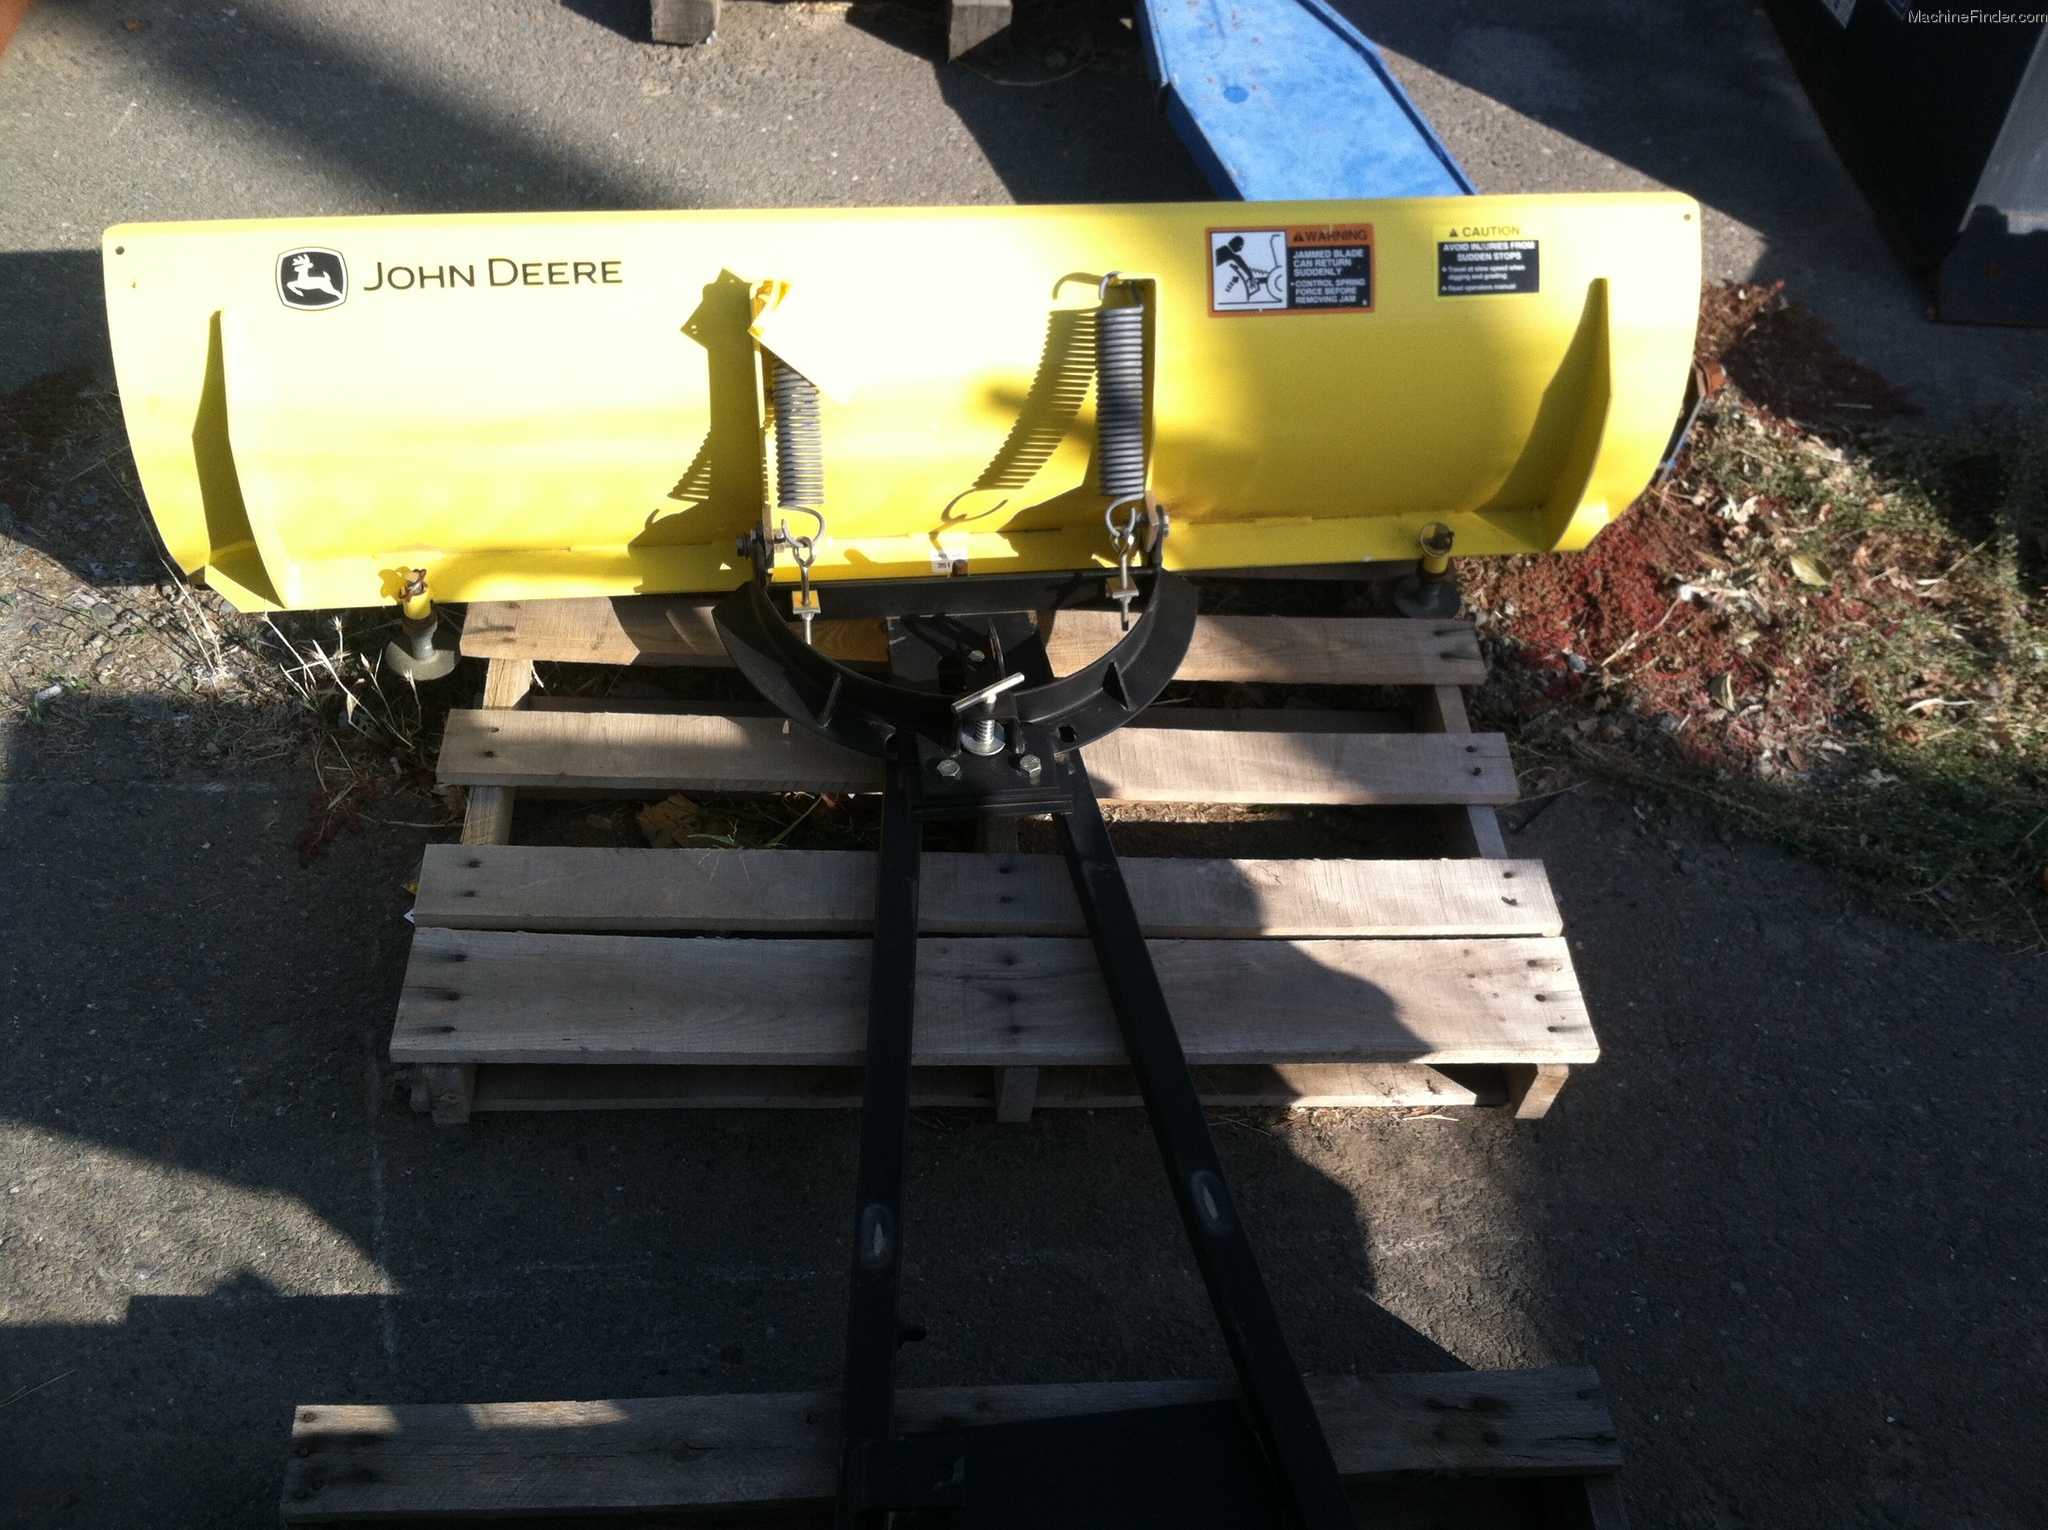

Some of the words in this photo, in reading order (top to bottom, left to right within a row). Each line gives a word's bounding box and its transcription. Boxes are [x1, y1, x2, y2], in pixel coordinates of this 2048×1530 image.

[1305, 230, 1367, 241] WARNING
[1462, 226, 1520, 237] CAUTION
[1443, 243, 1470, 251] AVOID
[1471, 242, 1509, 250] INJURIES
[1510, 241, 1535, 249] FROM
[1293, 250, 1332, 259] JAMMED
[1333, 249, 1364, 258] BLADE
[1457, 253, 1492, 261] SUDDEN
[1493, 251, 1521, 260] STOPS
[1315, 258, 1352, 267] RETURN
[363, 261, 475, 291] JOHN
[488, 258, 623, 287] DEERE
[1293, 268, 1343, 277] SUDDENLY
[1335, 278, 1366, 286] SPRING
[1324, 286, 1357, 295] BEFORE
[1339, 295, 1357, 303] JAM
